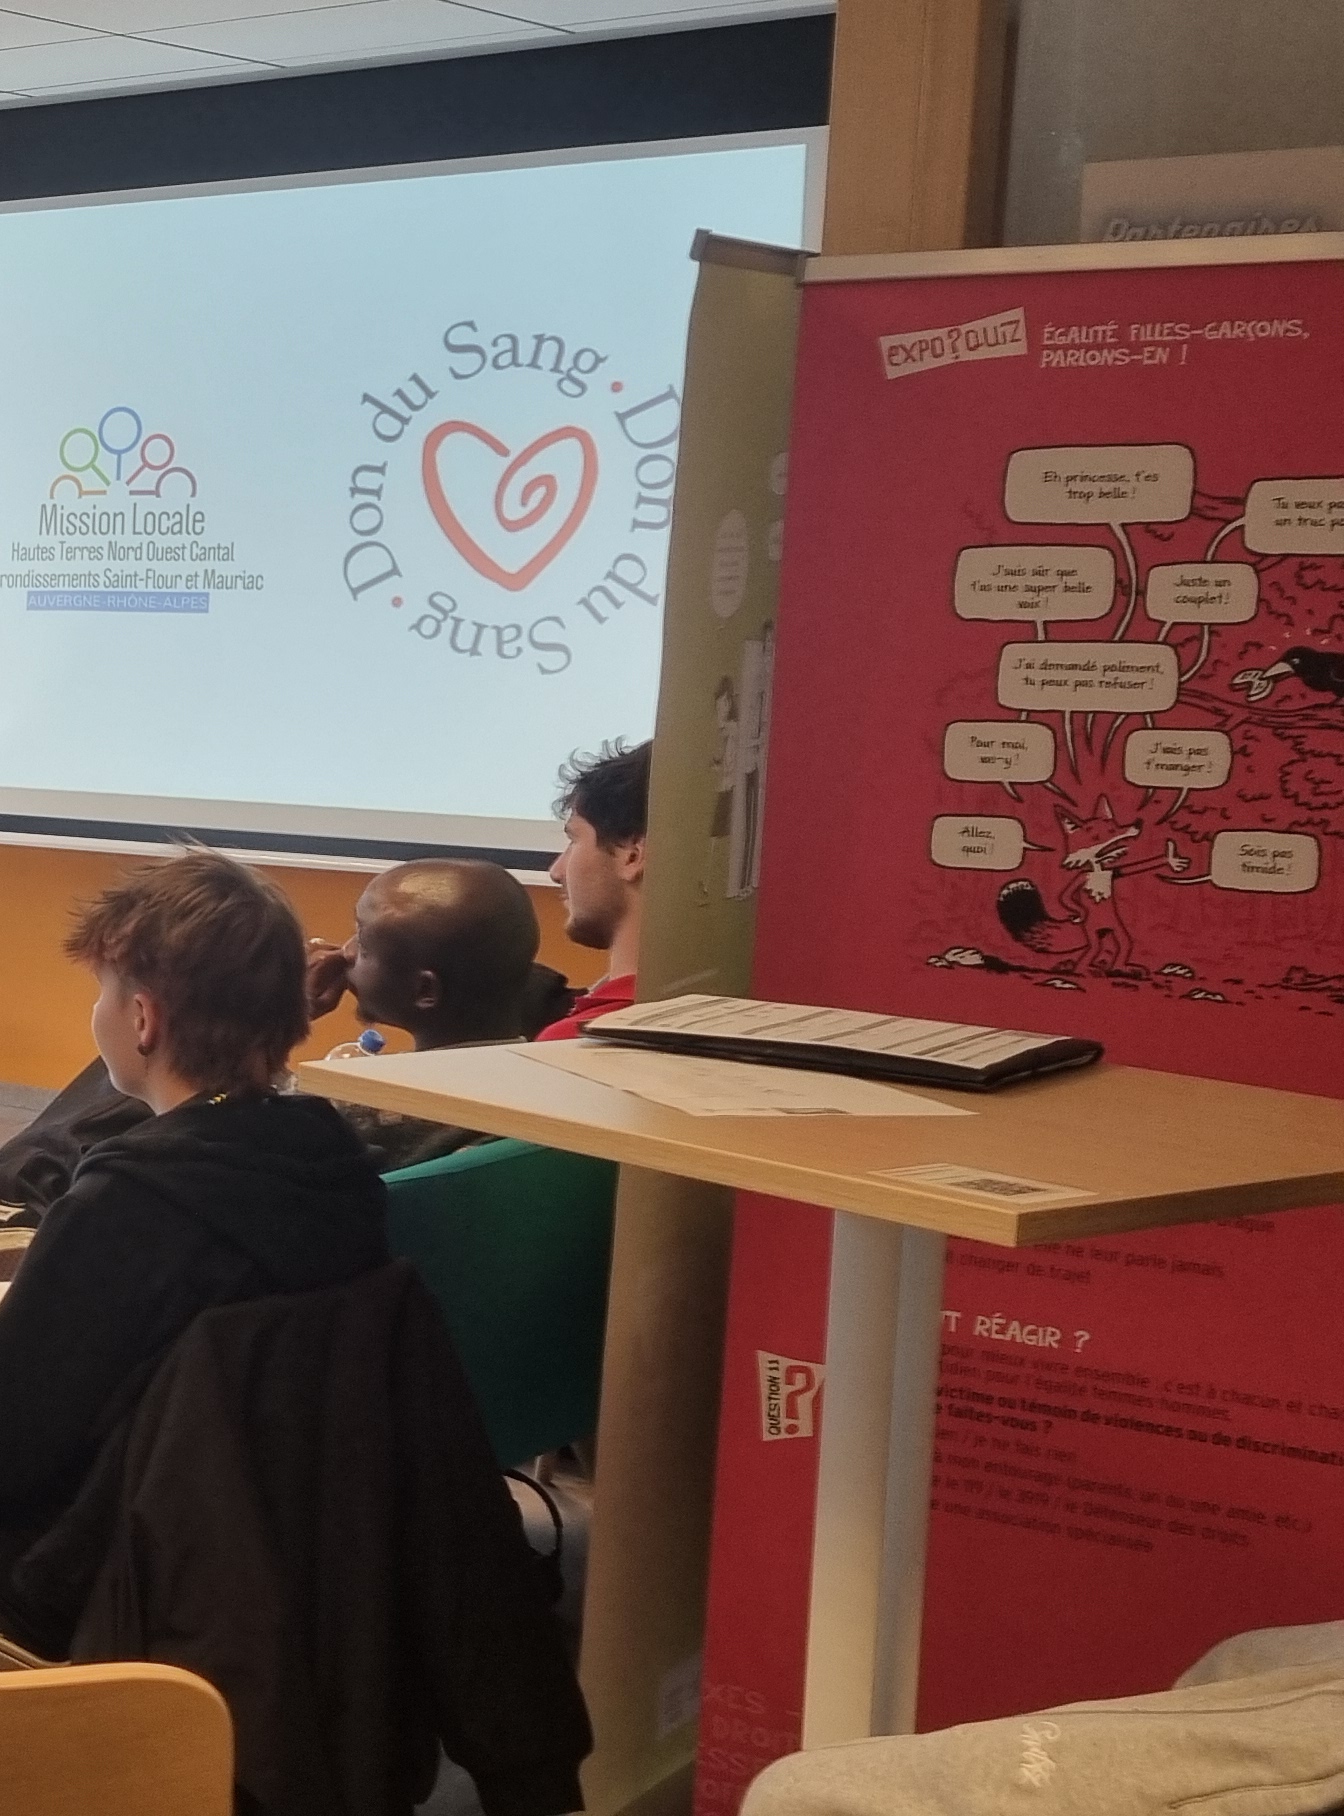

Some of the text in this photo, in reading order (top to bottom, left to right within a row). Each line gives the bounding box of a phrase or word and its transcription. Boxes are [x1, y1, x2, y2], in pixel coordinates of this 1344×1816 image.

[1042, 323, 1118, 346] ÉGALITÉ
[1040, 348, 1168, 368] PARLONS-EN
[343, 320, 608, 601] Don du Sang
[1066, 489, 1128, 501] trop belle
[39, 502, 205, 536] Mission Locale
[408, 384, 681, 675] Don du Sang
[11, 540, 235, 562] Hautes Terres Nord Ouest Cantal
[103, 568, 182, 590] Saint-Flour
[185, 573, 199, 590] et
[203, 569, 264, 591] Mauriac
[1056, 568, 1078, 581] que
[1024, 583, 1059, 596] super
[1064, 583, 1093, 593] belle
[28, 594, 208, 609] AUVERGNE-RHÔNE-ALPES
[1042, 678, 1069, 690] peux
[1074, 678, 1093, 692] pas
[1098, 677, 1145, 690] refuser
[970, 736, 996, 749] Pour
[1189, 747, 1209, 760] pas
[1272, 849, 1293, 863] pas
[973, 1312, 1062, 1350] RÉAGIR
[1074, 1330, 1090, 1352] ?
[767, 1359, 781, 1436] QUESTION 11
